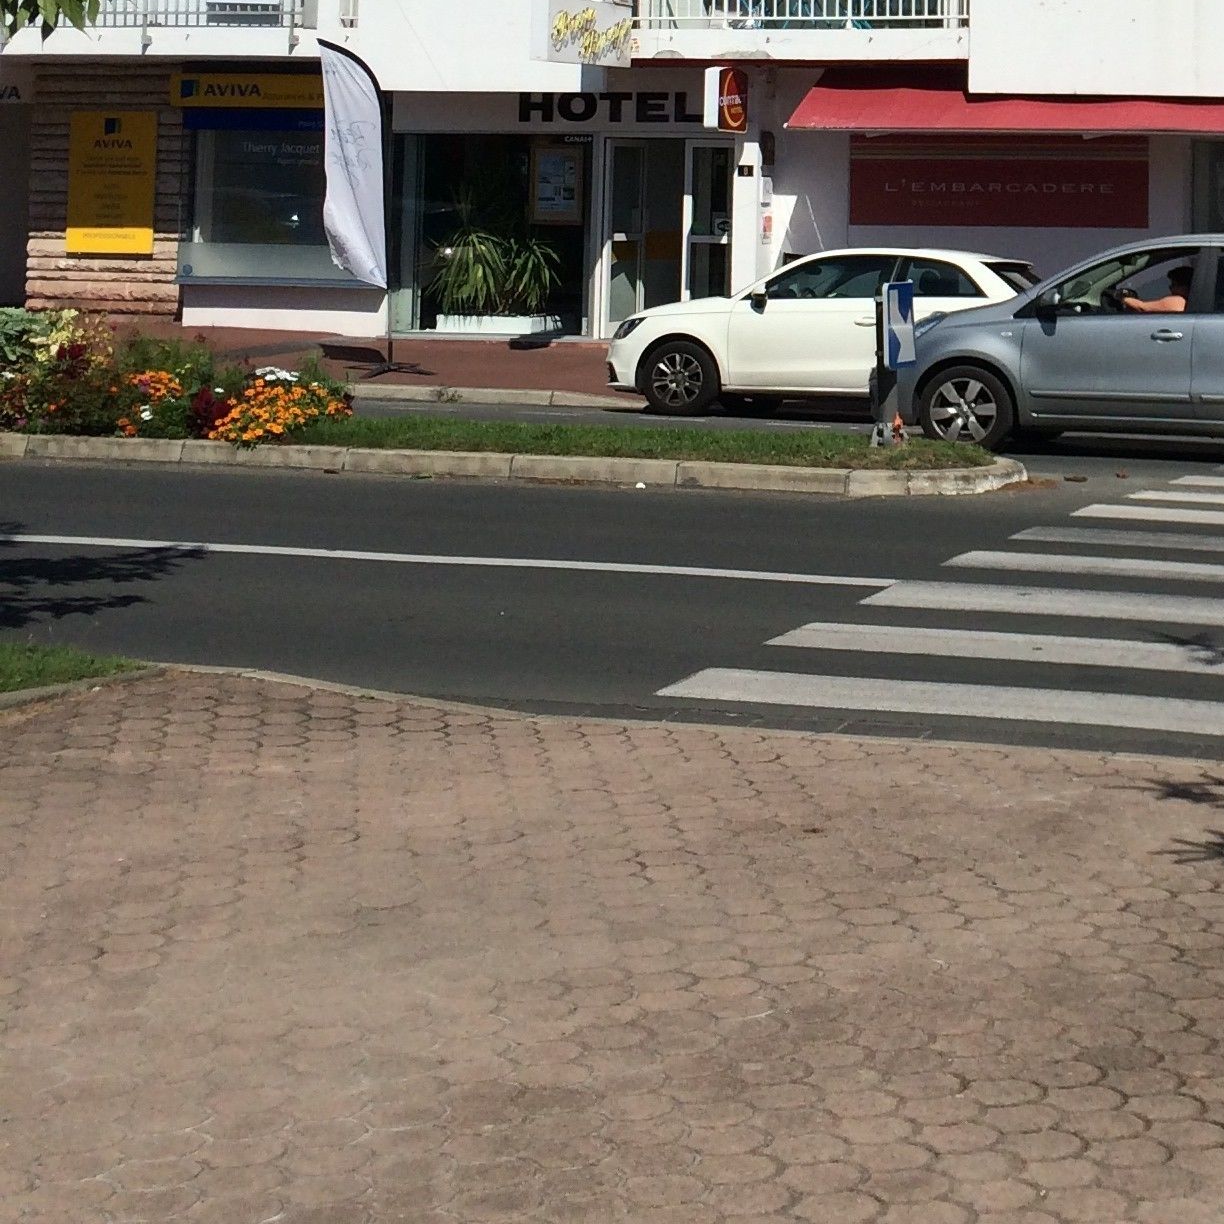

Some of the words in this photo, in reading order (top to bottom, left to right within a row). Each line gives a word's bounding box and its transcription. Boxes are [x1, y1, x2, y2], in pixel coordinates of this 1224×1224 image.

[204, 83, 262, 97] AVIVA
[518, 91, 705, 123] HOTEL
[94, 139, 133, 149] AVIVA
[241, 141, 278, 156] Thierry
[885, 178, 1115, 194] L'EMBARCADERE
